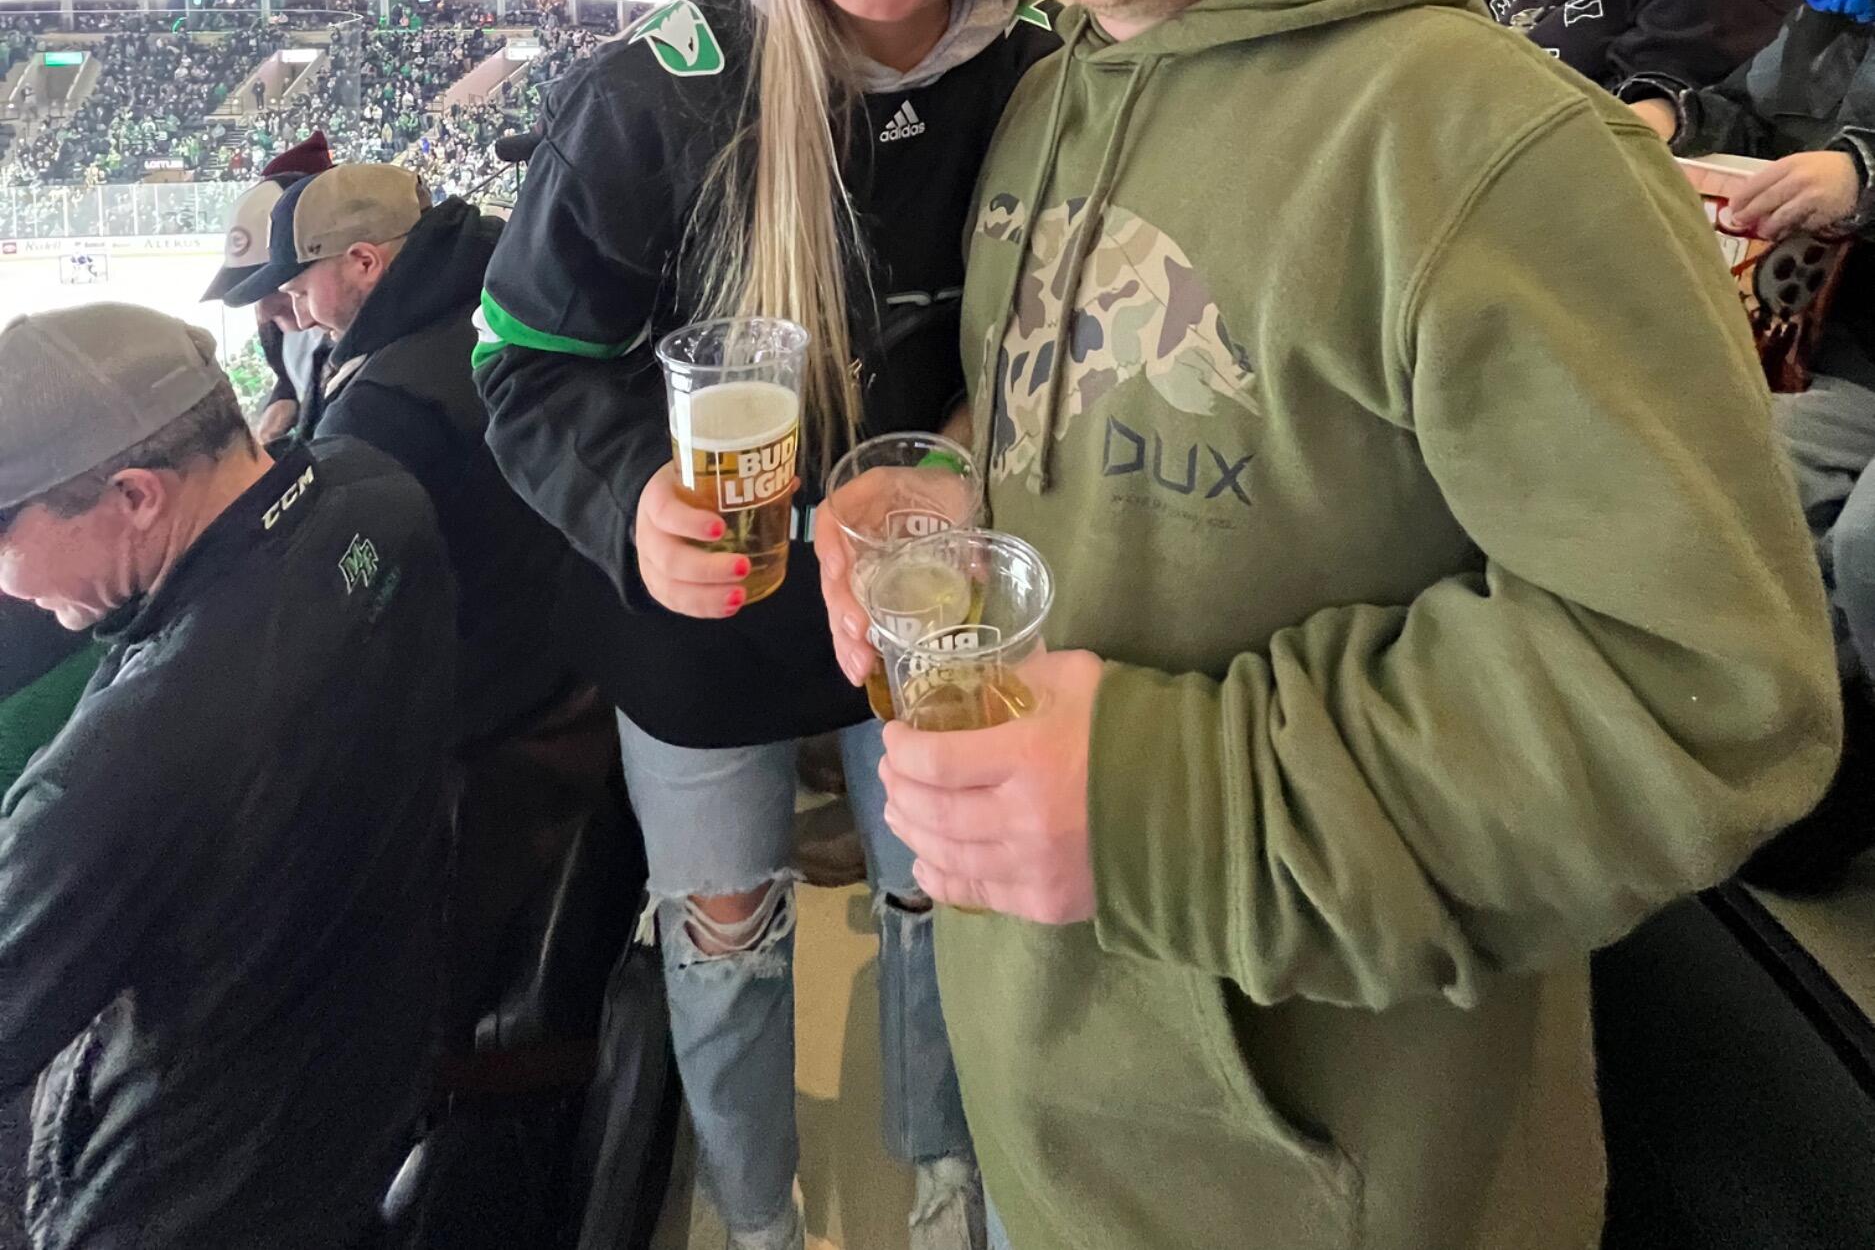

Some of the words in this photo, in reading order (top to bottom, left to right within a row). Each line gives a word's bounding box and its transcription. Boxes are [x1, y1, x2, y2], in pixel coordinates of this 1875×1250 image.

[879, 121, 926, 142] adidas
[738, 434, 795, 479] BUD
[1103, 414, 1256, 507] DUX
[261, 465, 315, 530] CCM
